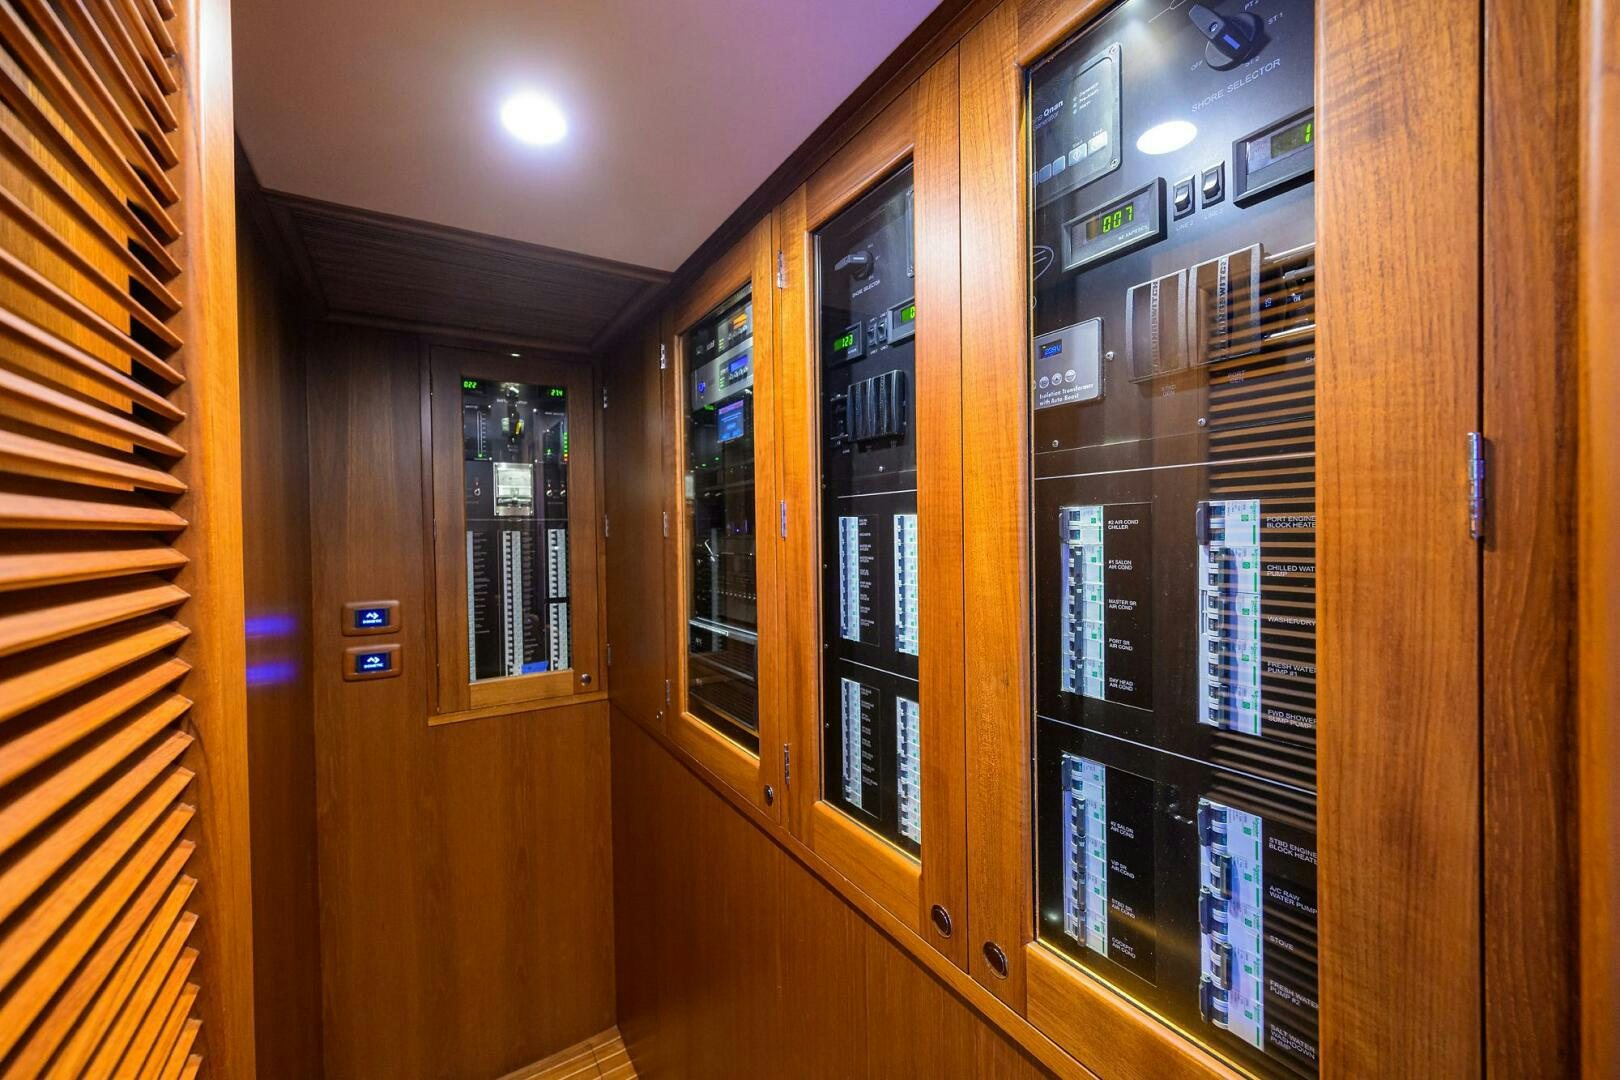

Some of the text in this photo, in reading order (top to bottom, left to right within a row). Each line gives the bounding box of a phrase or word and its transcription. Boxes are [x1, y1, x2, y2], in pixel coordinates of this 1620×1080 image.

[1191, 58, 1281, 112] SHORE SELECTOR
[1043, 100, 1064, 117] Onan
[1266, 521, 1292, 529] BLOCK
[1266, 564, 1298, 572] CHILLED
[1108, 598, 1129, 606] MASTER
[1267, 616, 1316, 627] WASHER/DRY
[1267, 660, 1292, 670] FRESH
[1267, 666, 1289, 675] PUMP
[1118, 684, 1134, 692] COND
[1267, 709, 1285, 718] FWD
[1268, 715, 1312, 729] SUMP PUMP
[1119, 829, 1135, 839] COND
[1268, 836, 1318, 859] STBD ENGINE
[1268, 842, 1318, 865] BLOCK HEATE
[1269, 885, 1302, 901] A/C RAW
[1269, 891, 1317, 914] WATER PUMP
[1120, 907, 1136, 919] COND
[1269, 935, 1294, 951] STOVE
[1269, 979, 1294, 997] FRESH
[1269, 985, 1291, 999] PUMP
[1270, 1023, 1315, 1054] SALT WATER
[1270, 1035, 1291, 1050] PUMP
[1270, 1030, 1315, 1060] WASHDOWN
